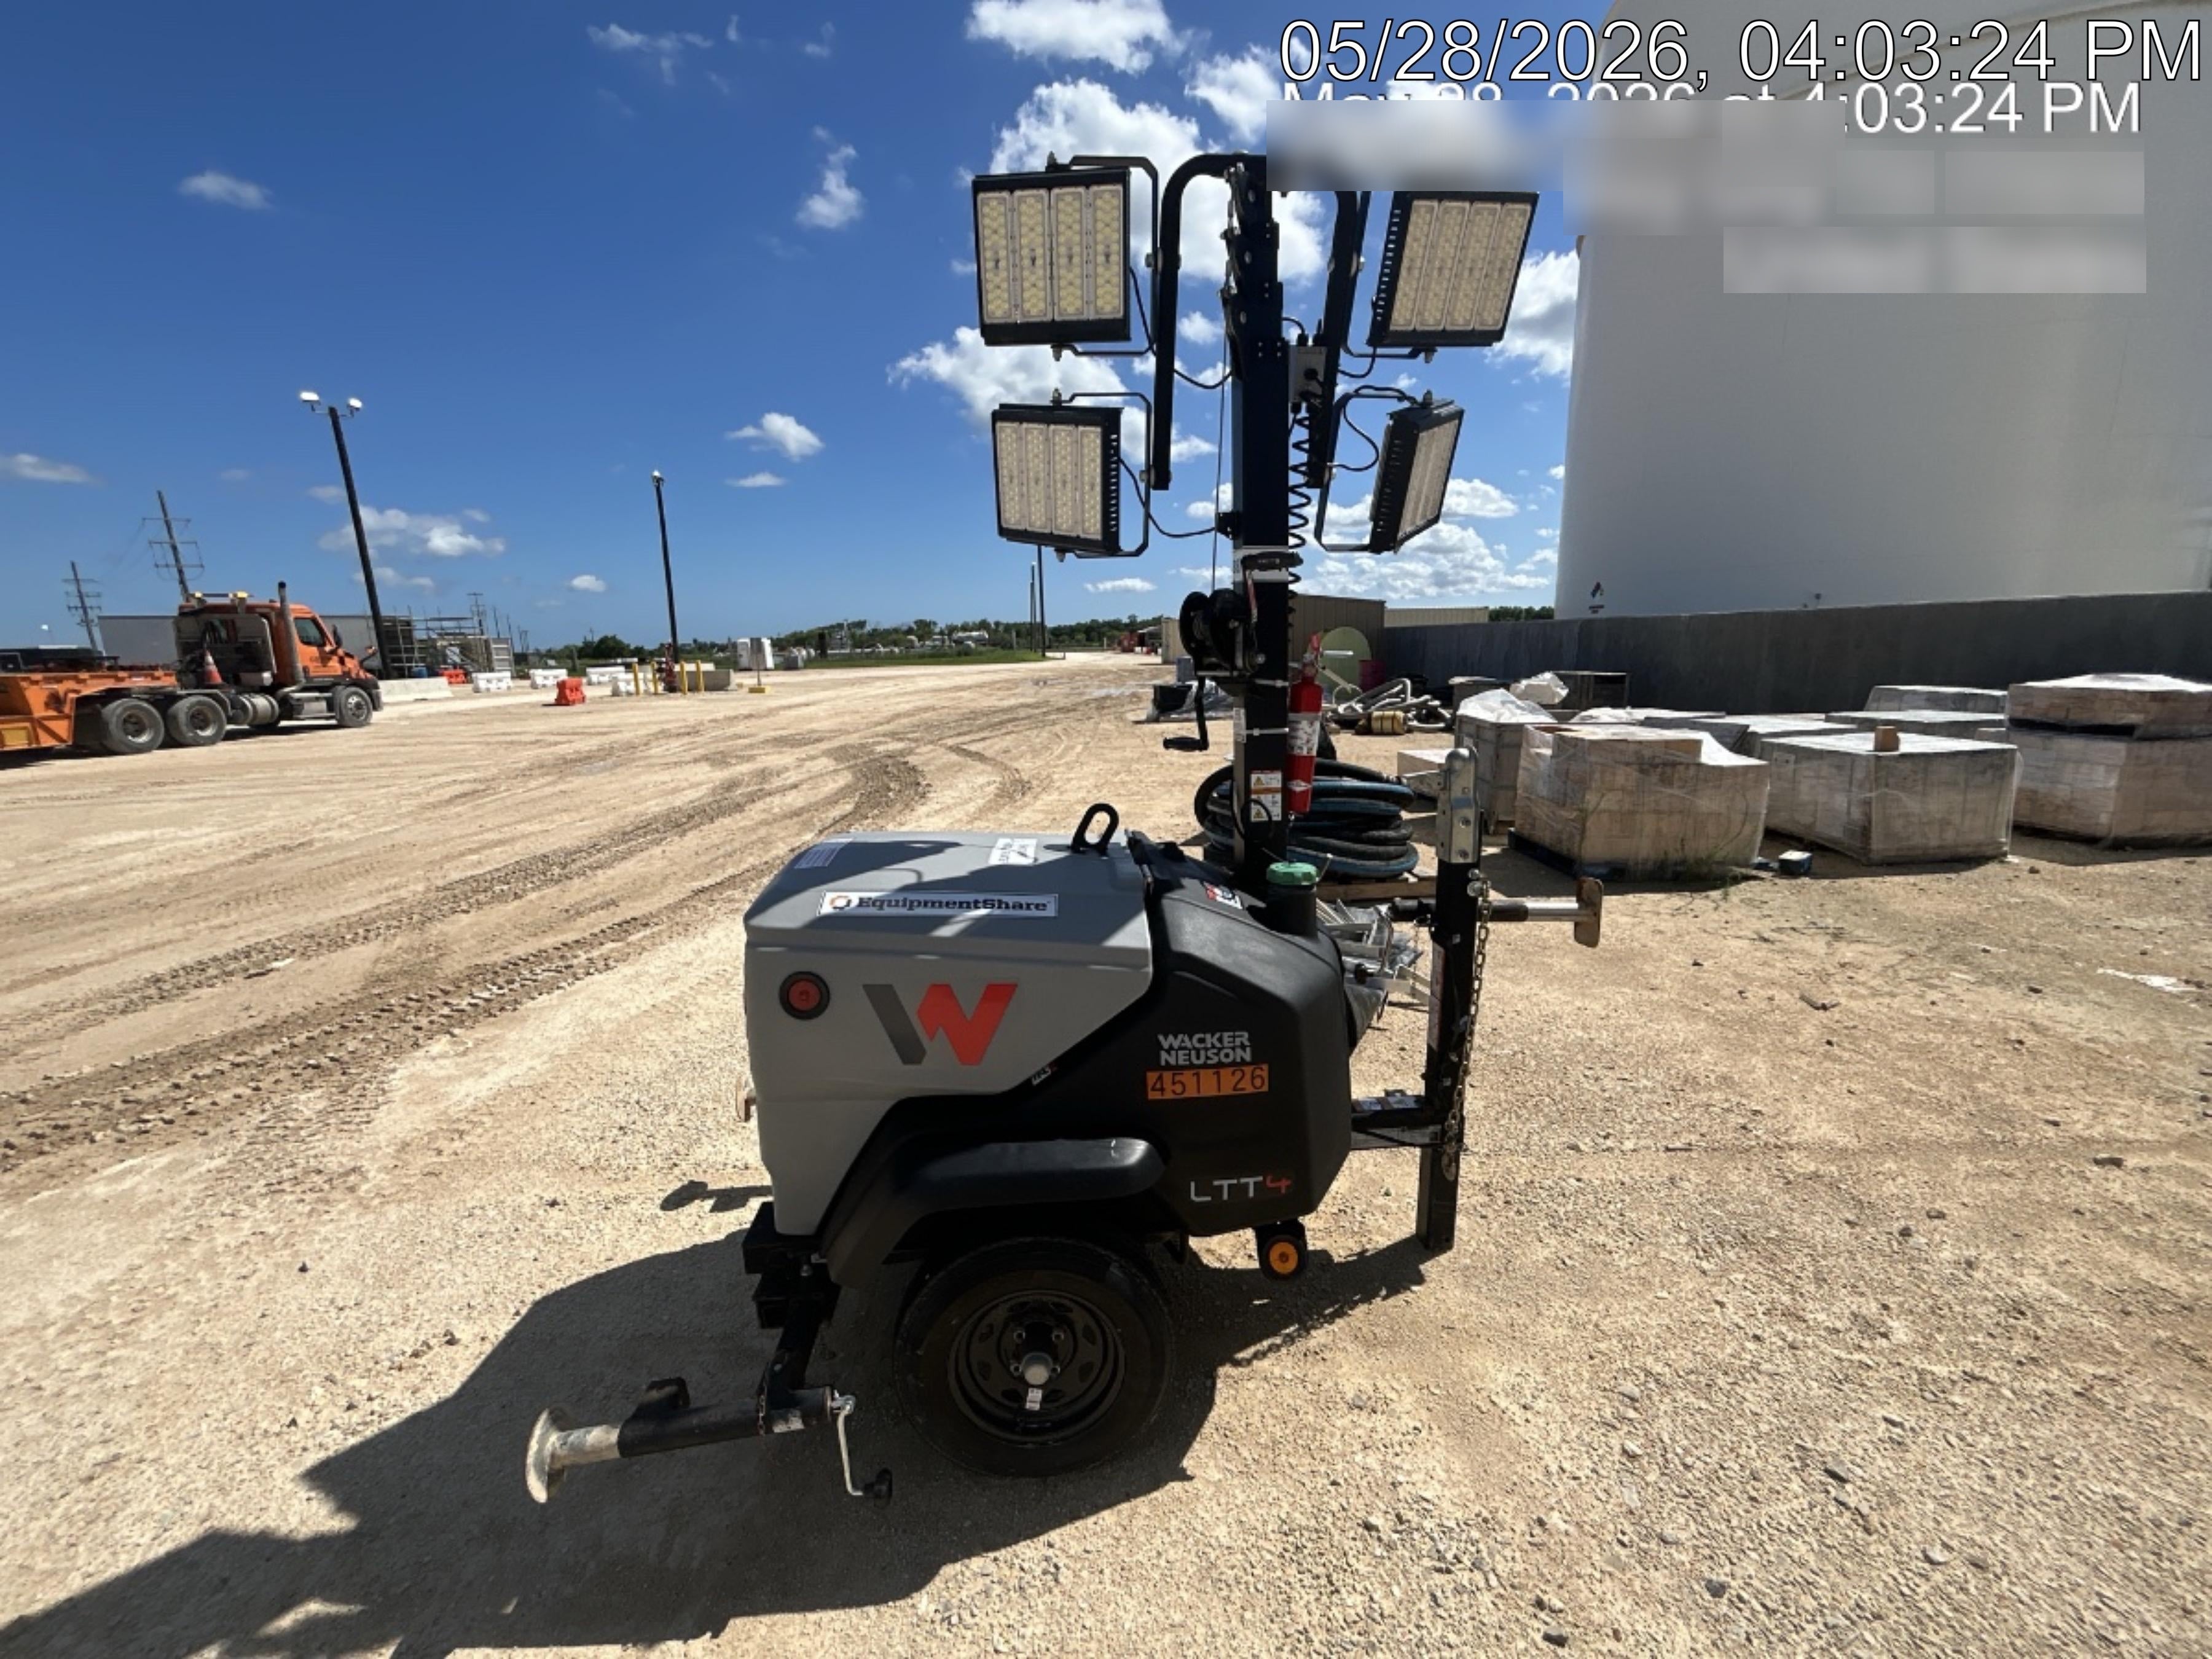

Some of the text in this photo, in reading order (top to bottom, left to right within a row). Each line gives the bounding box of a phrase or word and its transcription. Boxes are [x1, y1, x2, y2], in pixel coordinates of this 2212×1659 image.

[857, 896, 1049, 912] EquipmentShare
[1158, 1032, 1251, 1049] WACKER
[1159, 1046, 1253, 1066] NEUSON
[1150, 1067, 1266, 1096] 451126
[1190, 1175, 1292, 1202] LTT4
